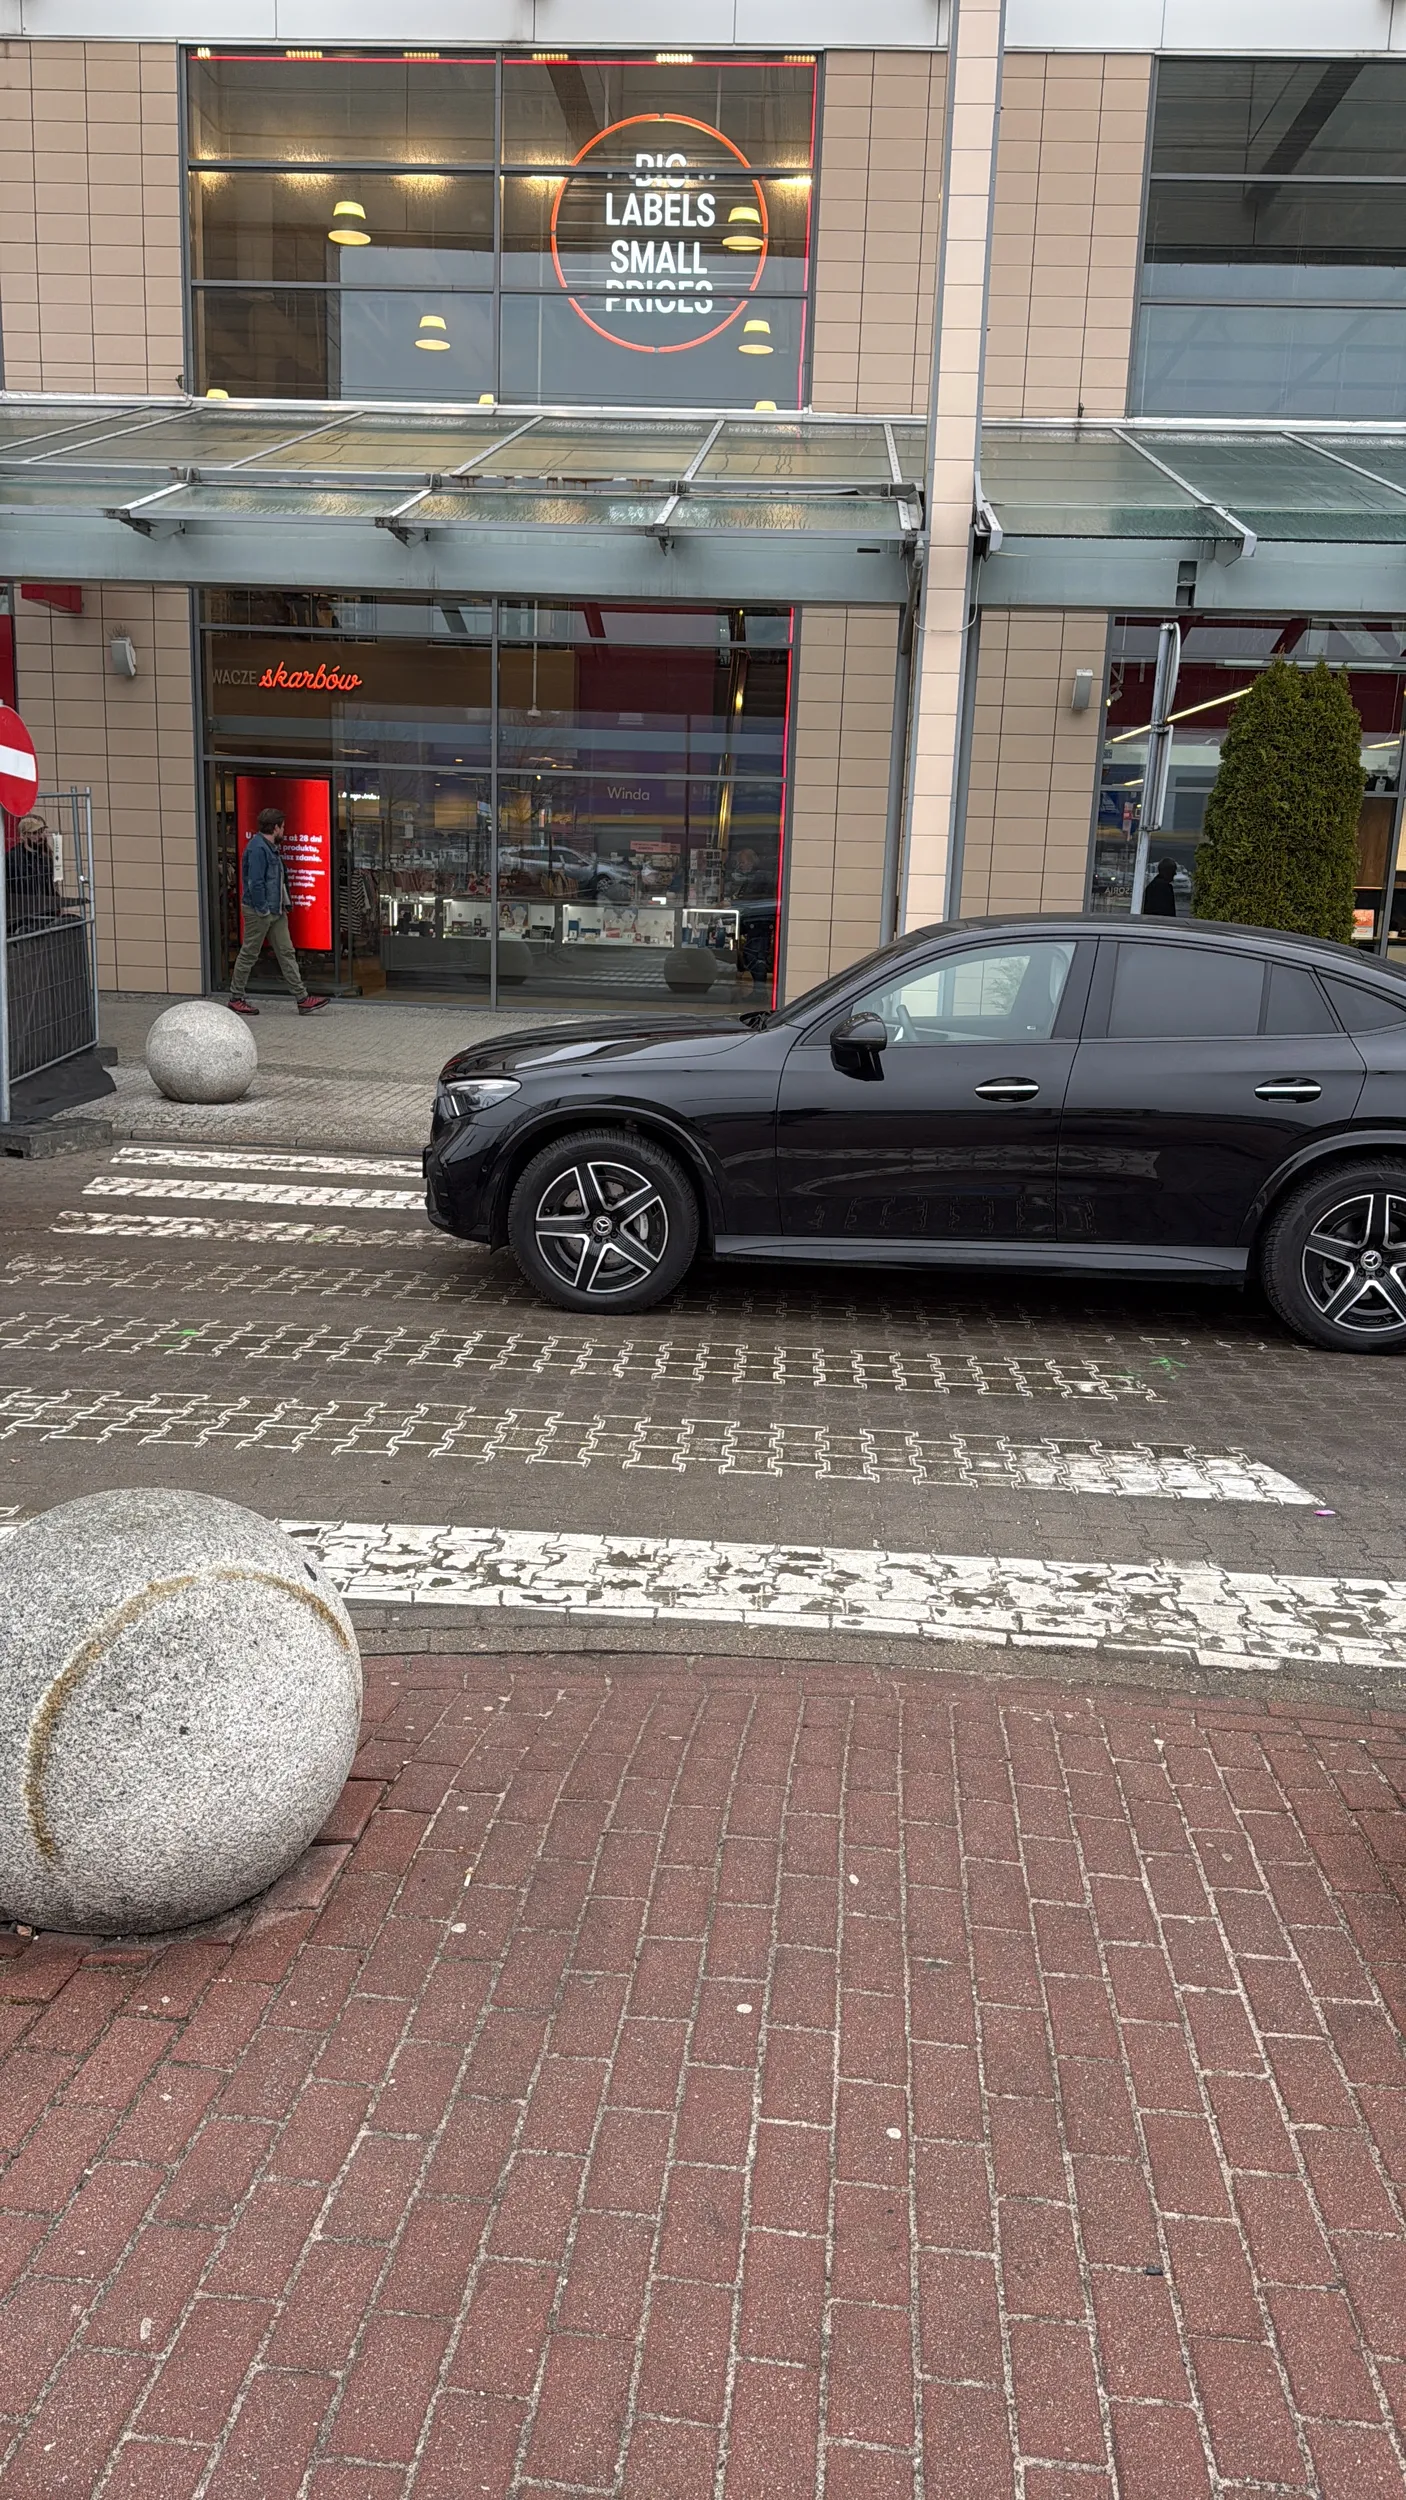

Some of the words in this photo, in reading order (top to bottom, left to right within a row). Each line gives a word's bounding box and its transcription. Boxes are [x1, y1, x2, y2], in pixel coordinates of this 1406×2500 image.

[635, 153, 687, 188] BIG
[605, 192, 716, 227] LABELS
[610, 239, 708, 275] SMALL
[605, 279, 713, 314] PRICES
[258, 661, 363, 691] skarbów
[607, 786, 651, 801] Winda
[299, 834, 308, 842] 28
